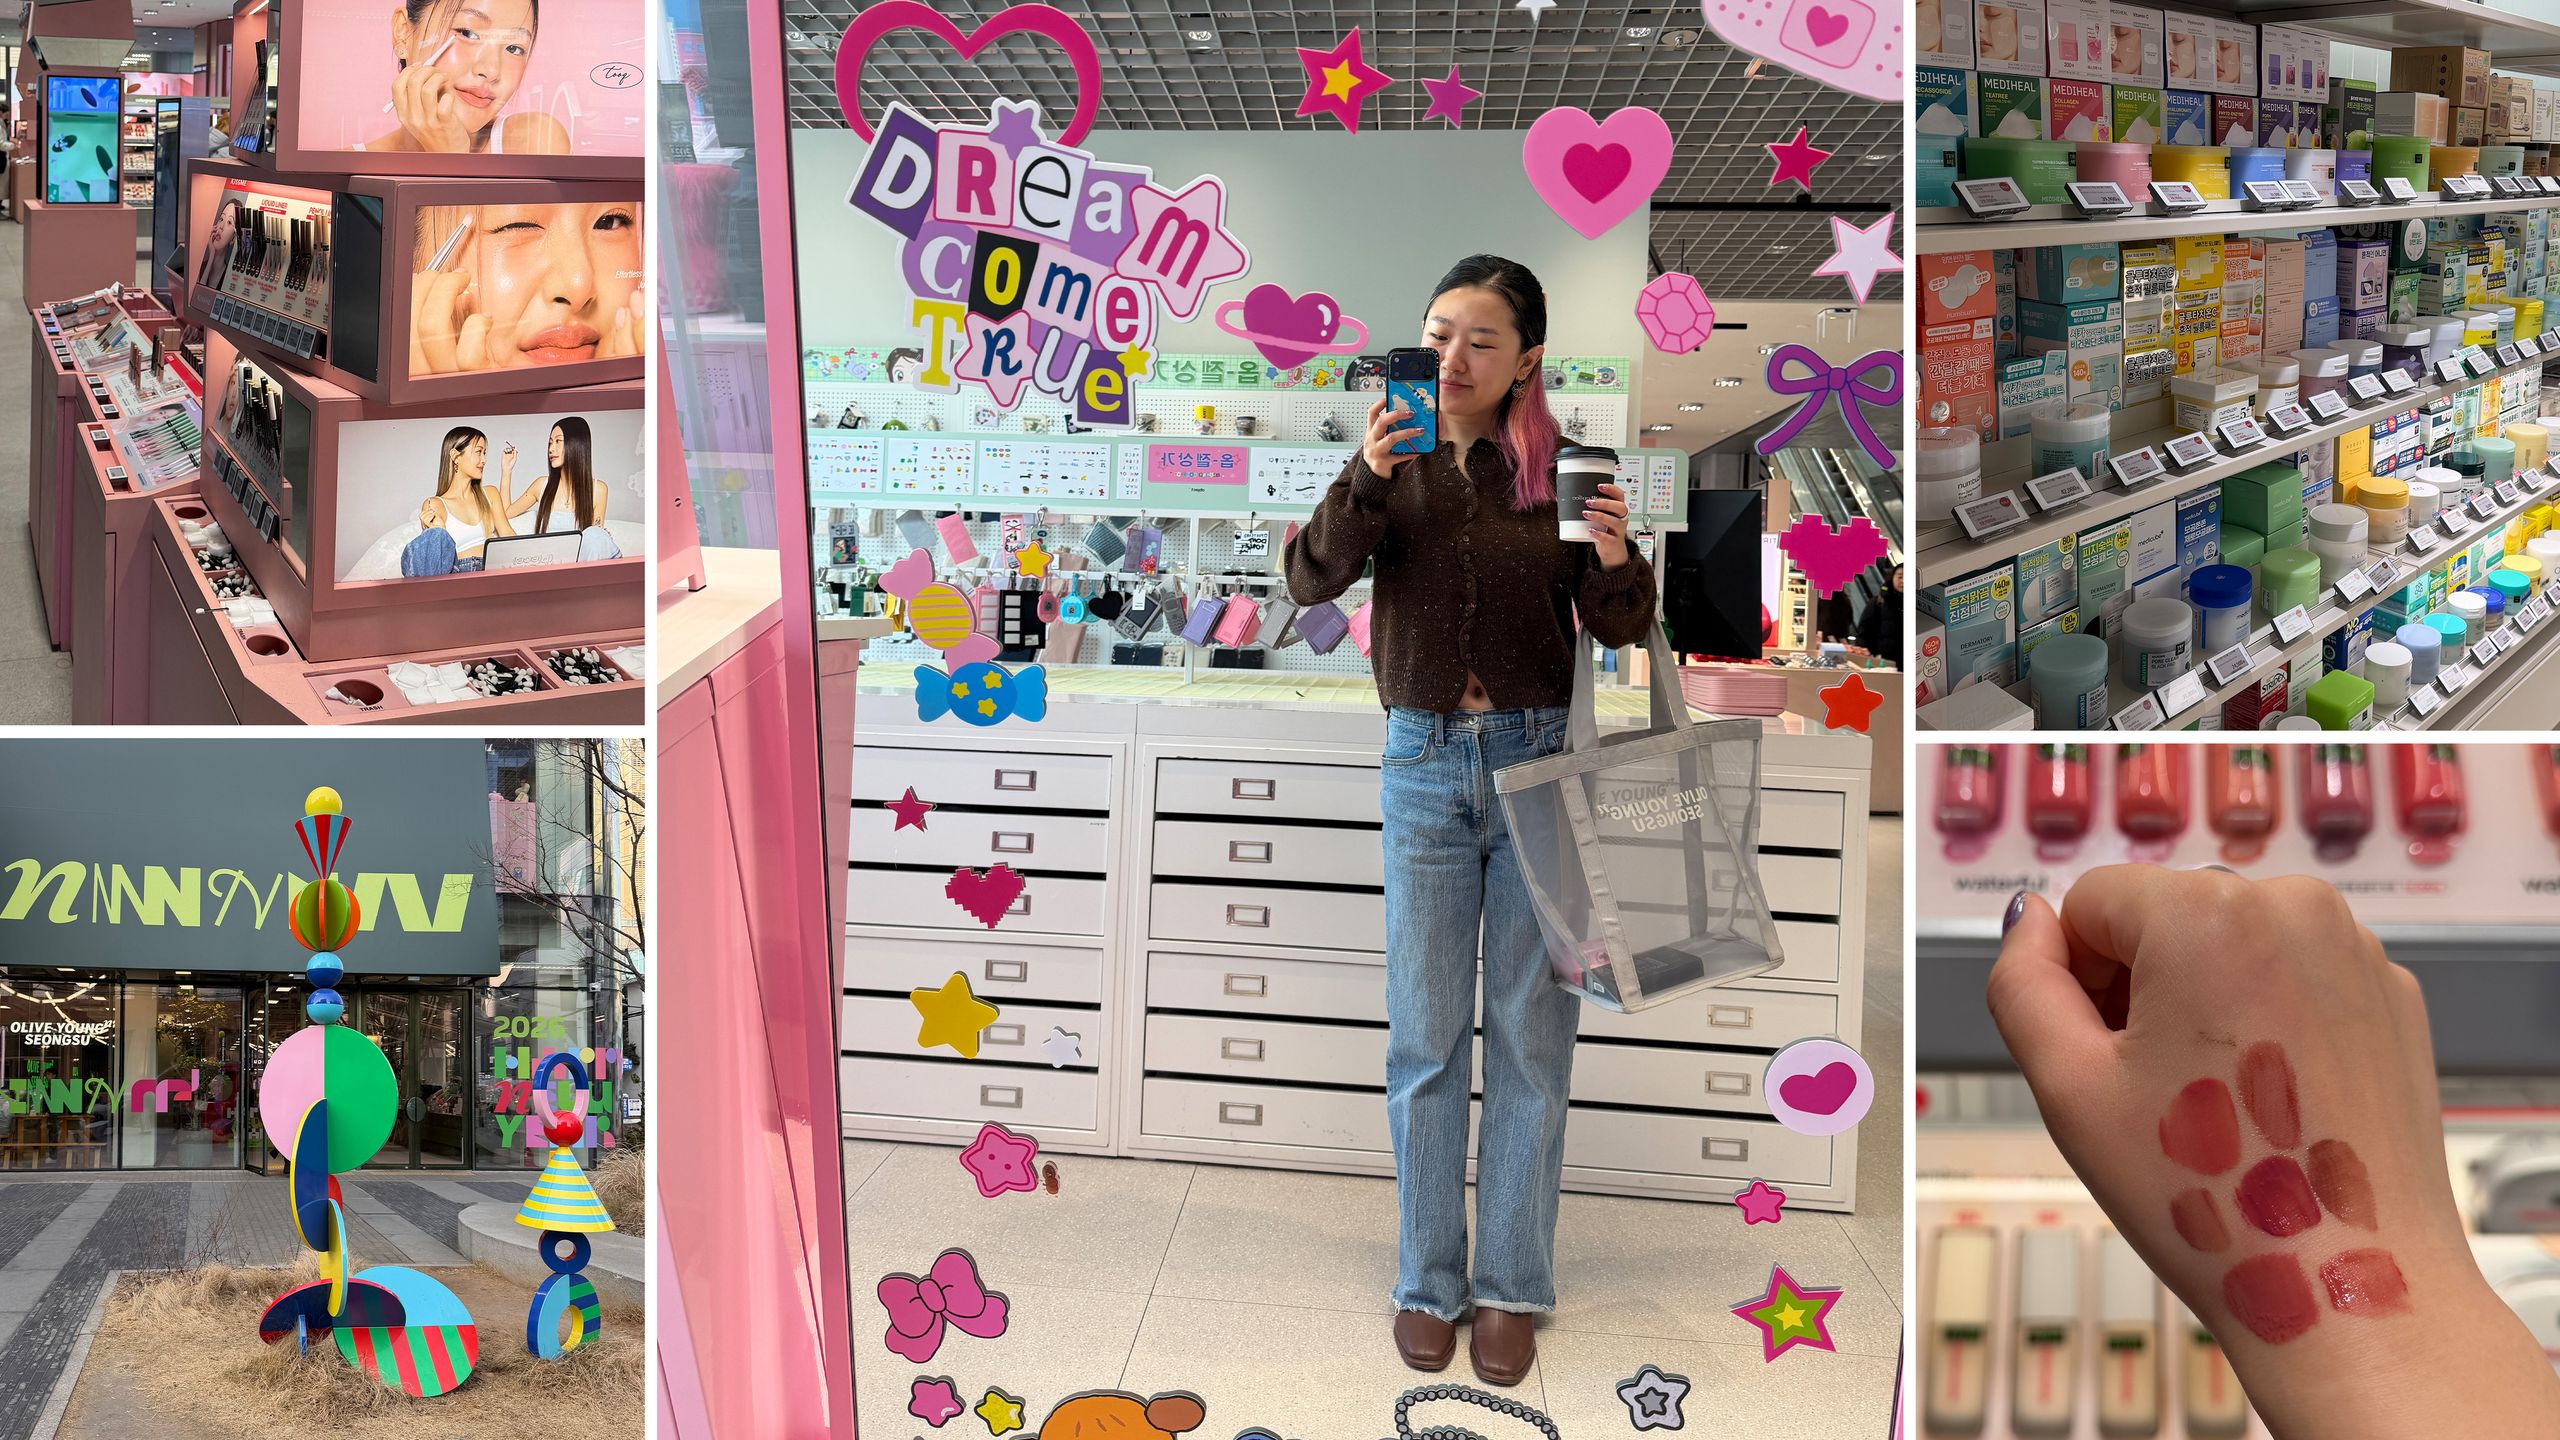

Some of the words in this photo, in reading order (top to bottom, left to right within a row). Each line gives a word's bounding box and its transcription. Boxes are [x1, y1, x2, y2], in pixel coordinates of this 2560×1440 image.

[1984, 78, 2036, 92] MEDIHEAL
[2053, 84, 2100, 98] MEDIHEAL
[2116, 90, 2157, 103] MEDIHEAL
[2166, 94, 2202, 107] MEDIHEAL
[2218, 99, 2251, 110] MEDIHEAL
[2261, 103, 2291, 113] MEDIHEAL
[1926, 349, 1945, 361] 각질
[1953, 344, 1971, 356] 모공
[1973, 341, 1993, 353] OUT
[1928, 360, 1967, 379] 깐달걀
[1968, 354, 1993, 370] 패드
[1937, 380, 1963, 395] 더블
[1964, 374, 1987, 389] 기획
[2137, 531, 2163, 547] medicube
[2020, 549, 2044, 560] DERMATORY
[2082, 548, 2114, 570] 모공패드
[2021, 565, 2050, 581] 진정패드
[2090, 581, 2116, 594] DERMATORY
[1949, 600, 1990, 623] 진정패드
[1997, 603, 2009, 611] ONLY
[2346, 616, 2359, 633] NO
[1960, 635, 1993, 650] DERMATORY
[2022, 630, 2046, 642] DERMATORY
[1925, 660, 1940, 670] ONLY
[2261, 672, 2287, 695] STRIDEX
[359, 704, 384, 713] TRASH
[10, 1021, 54, 1034] OLIVE
[493, 1015, 567, 1039] 2026
[24, 1033, 91, 1046] SEONGSU
